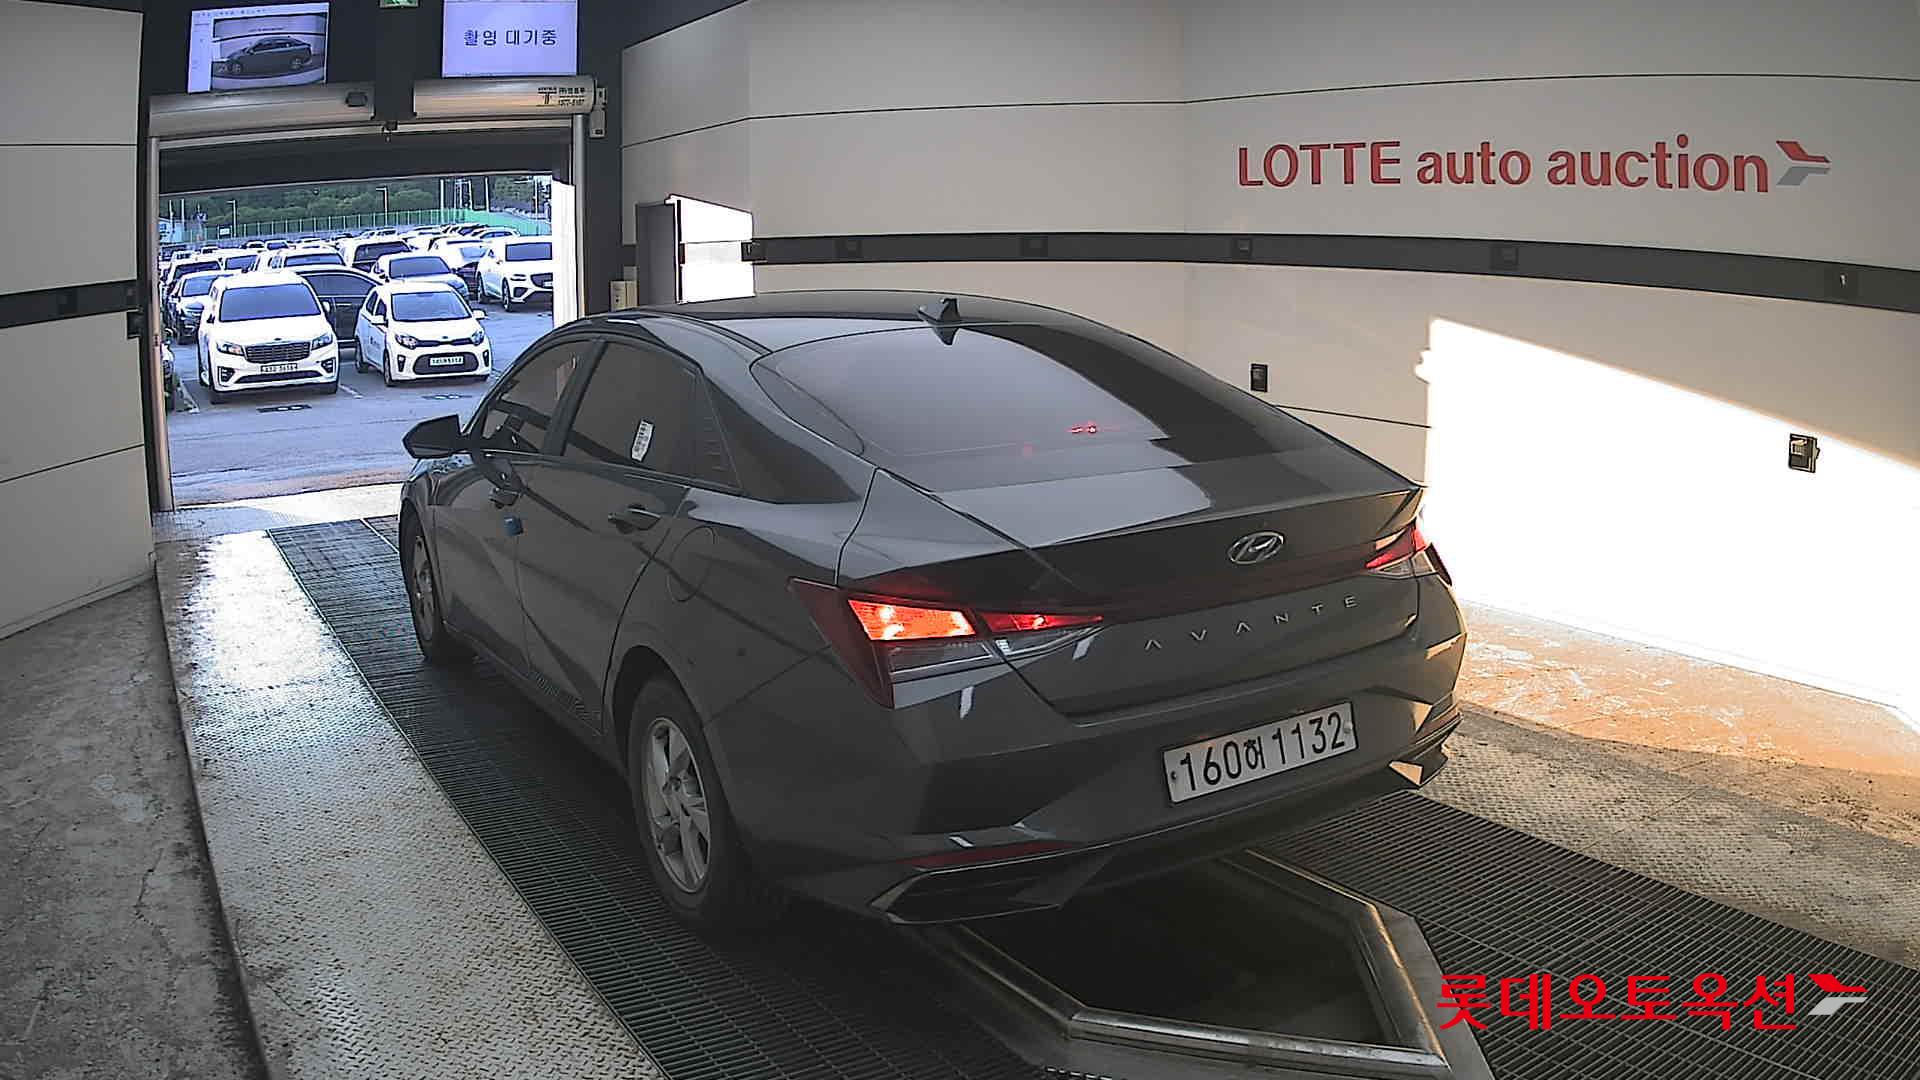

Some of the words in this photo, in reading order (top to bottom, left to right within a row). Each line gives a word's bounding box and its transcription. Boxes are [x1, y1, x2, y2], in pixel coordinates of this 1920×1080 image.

[463, 29, 497, 46] 촬영
[505, 29, 558, 46] 대기중
[1238, 140, 1401, 187] LOTTE
[1416, 141, 1532, 186] auto
[1547, 133, 1769, 193] auction
[1144, 594, 1358, 651] AVANTE
